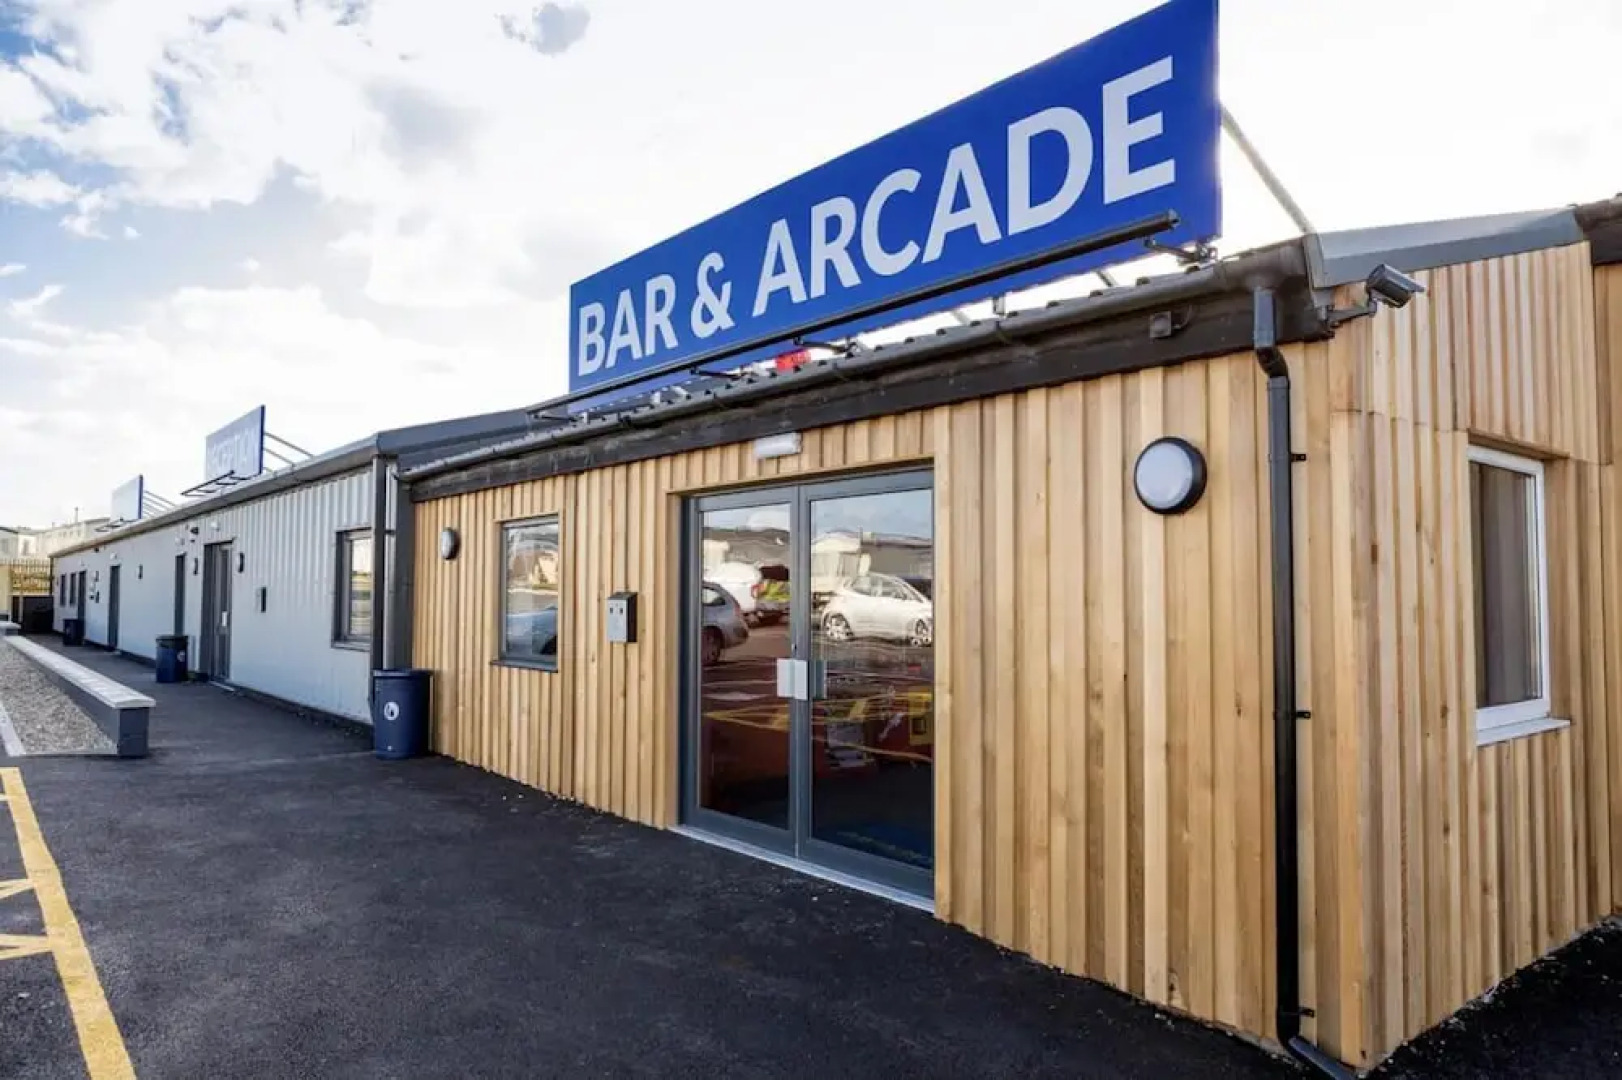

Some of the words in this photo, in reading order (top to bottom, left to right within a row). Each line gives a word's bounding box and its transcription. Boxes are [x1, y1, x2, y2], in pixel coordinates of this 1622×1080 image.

[578, 275, 679, 377] BAR
[690, 252, 735, 338] &
[753, 56, 1175, 316] ARCADE
